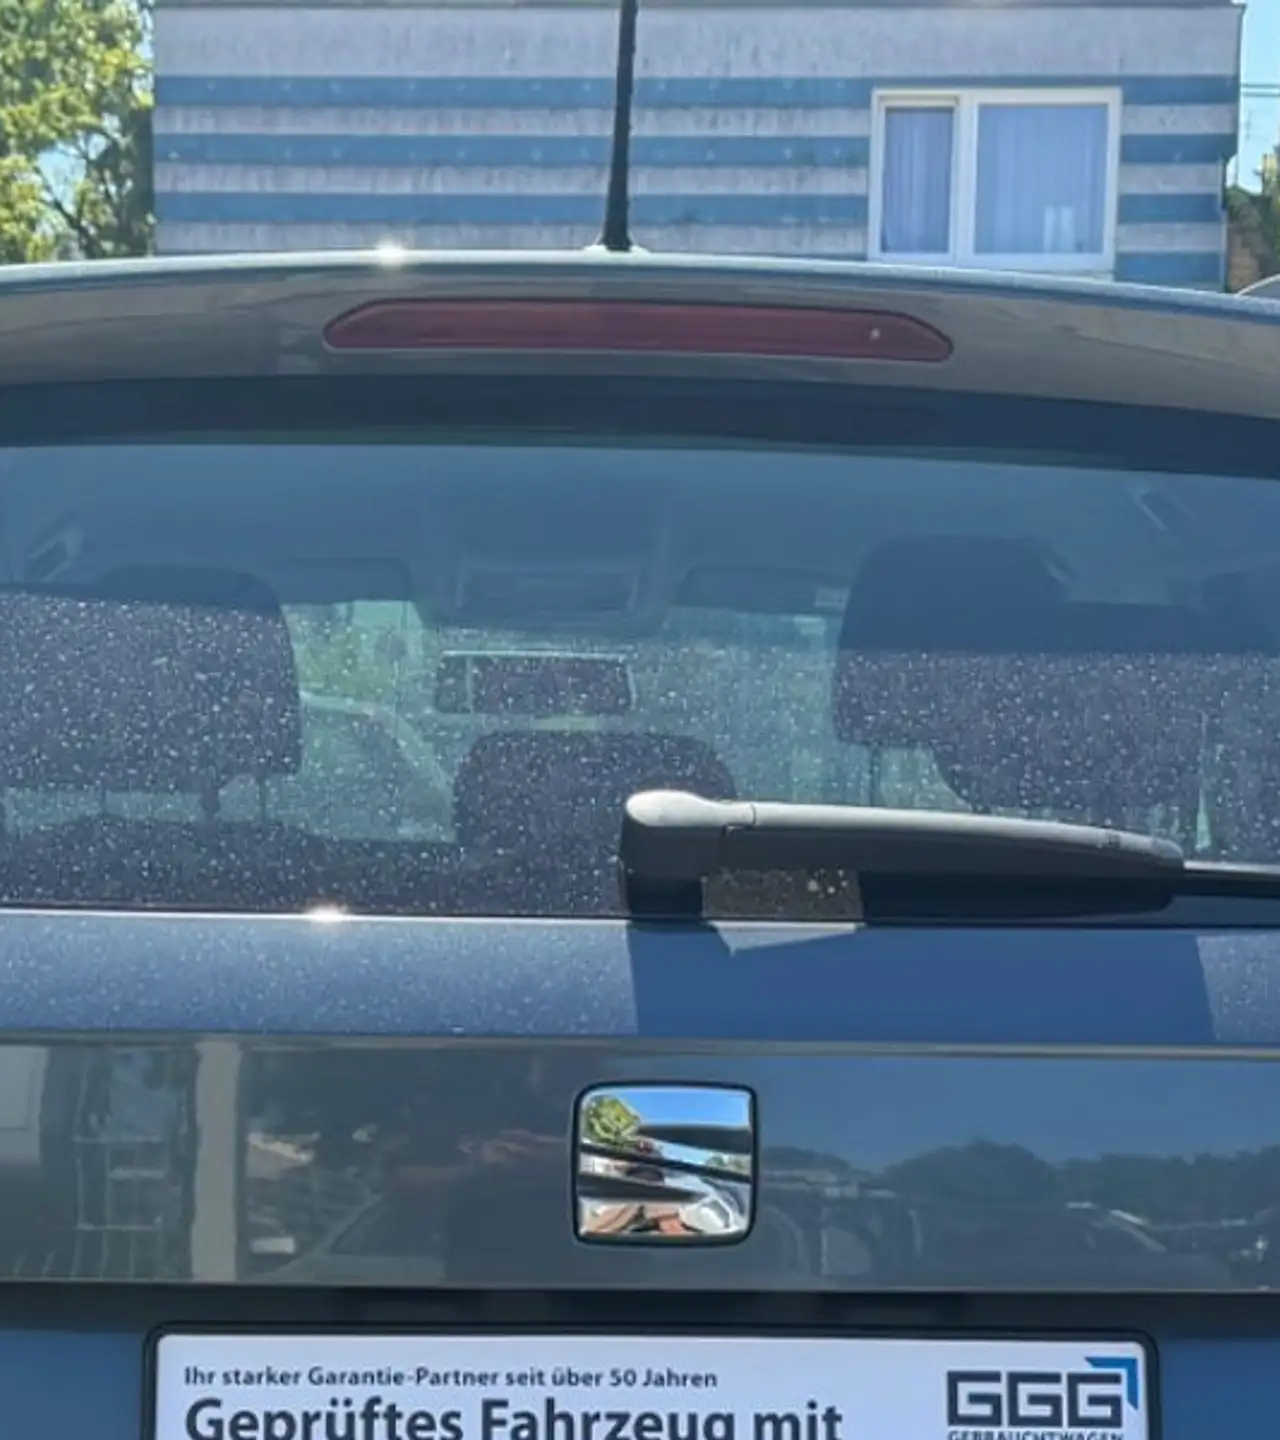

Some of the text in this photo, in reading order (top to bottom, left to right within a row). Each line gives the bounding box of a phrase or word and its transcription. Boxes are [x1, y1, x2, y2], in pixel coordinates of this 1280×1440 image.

[184, 1366, 718, 1388] Ihr starker Garantie-Partner seit über 50 Jahren
[947, 1370, 1124, 1429] GGG
